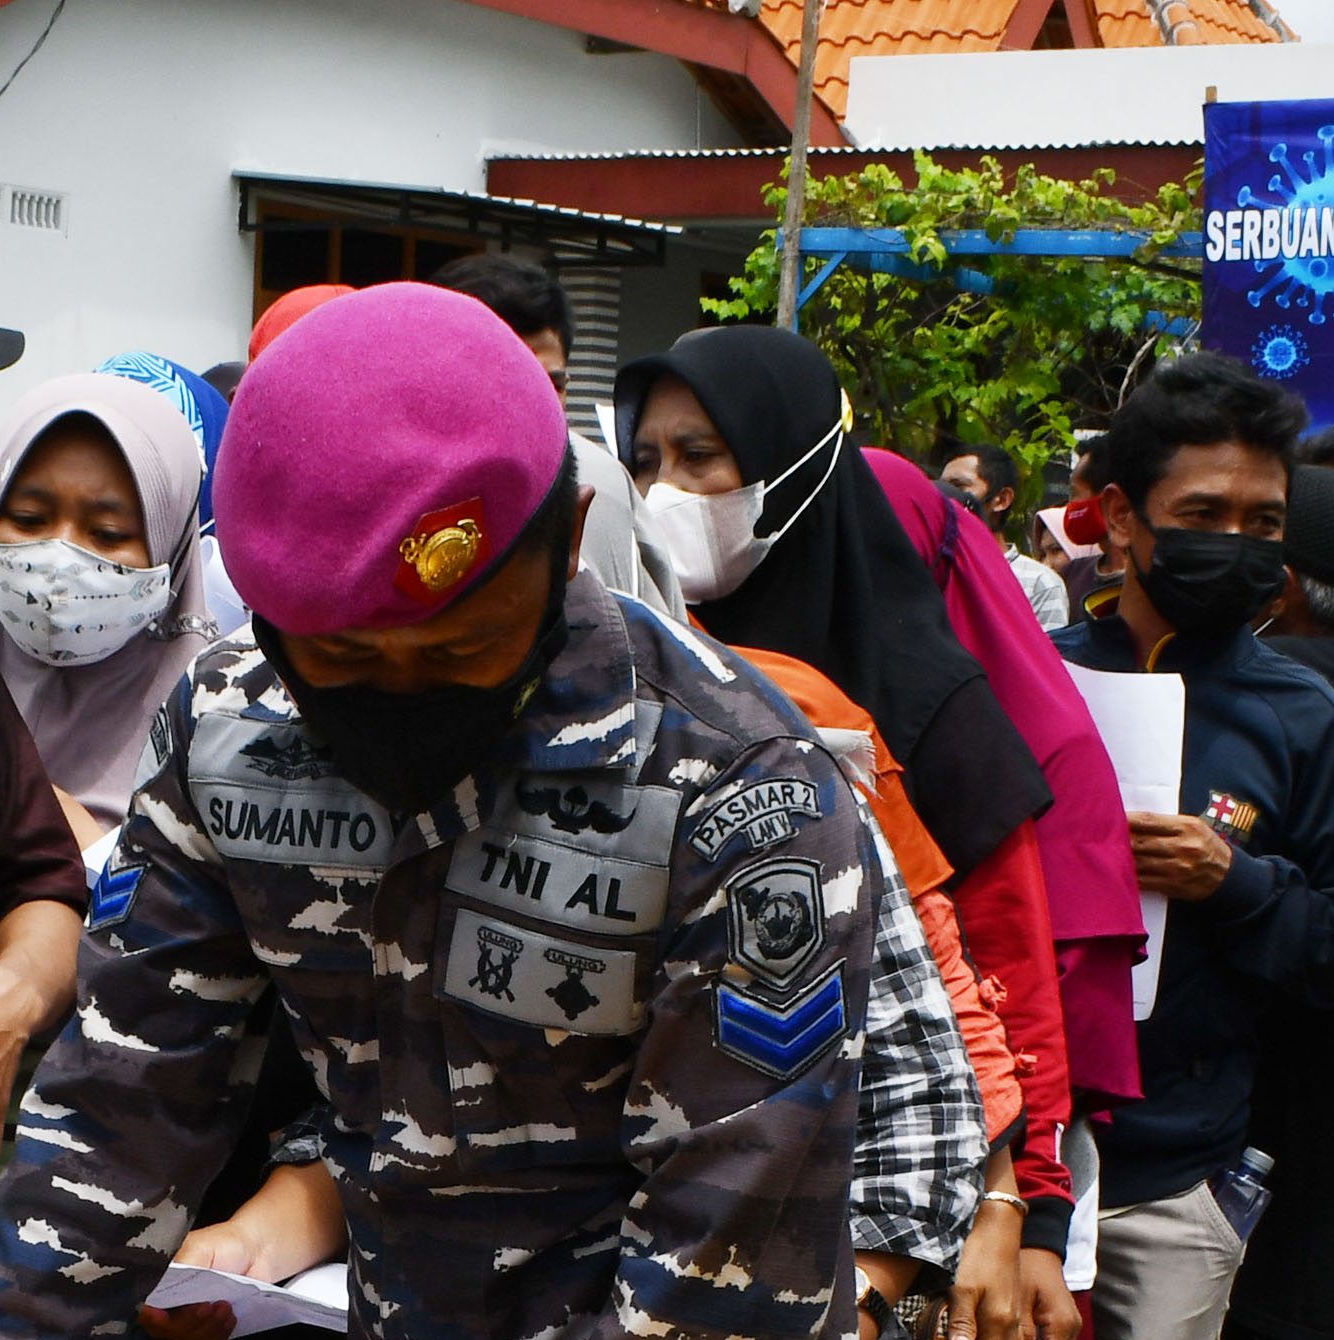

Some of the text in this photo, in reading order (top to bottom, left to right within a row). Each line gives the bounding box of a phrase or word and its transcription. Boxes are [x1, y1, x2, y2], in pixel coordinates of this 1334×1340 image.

[209, 797, 376, 852] SUMANTO
[697, 784, 812, 849] PASMAR 2
[480, 842, 637, 923] TNI AL
[482, 930, 518, 949] ULUNG
[551, 951, 598, 970] ULUNG
